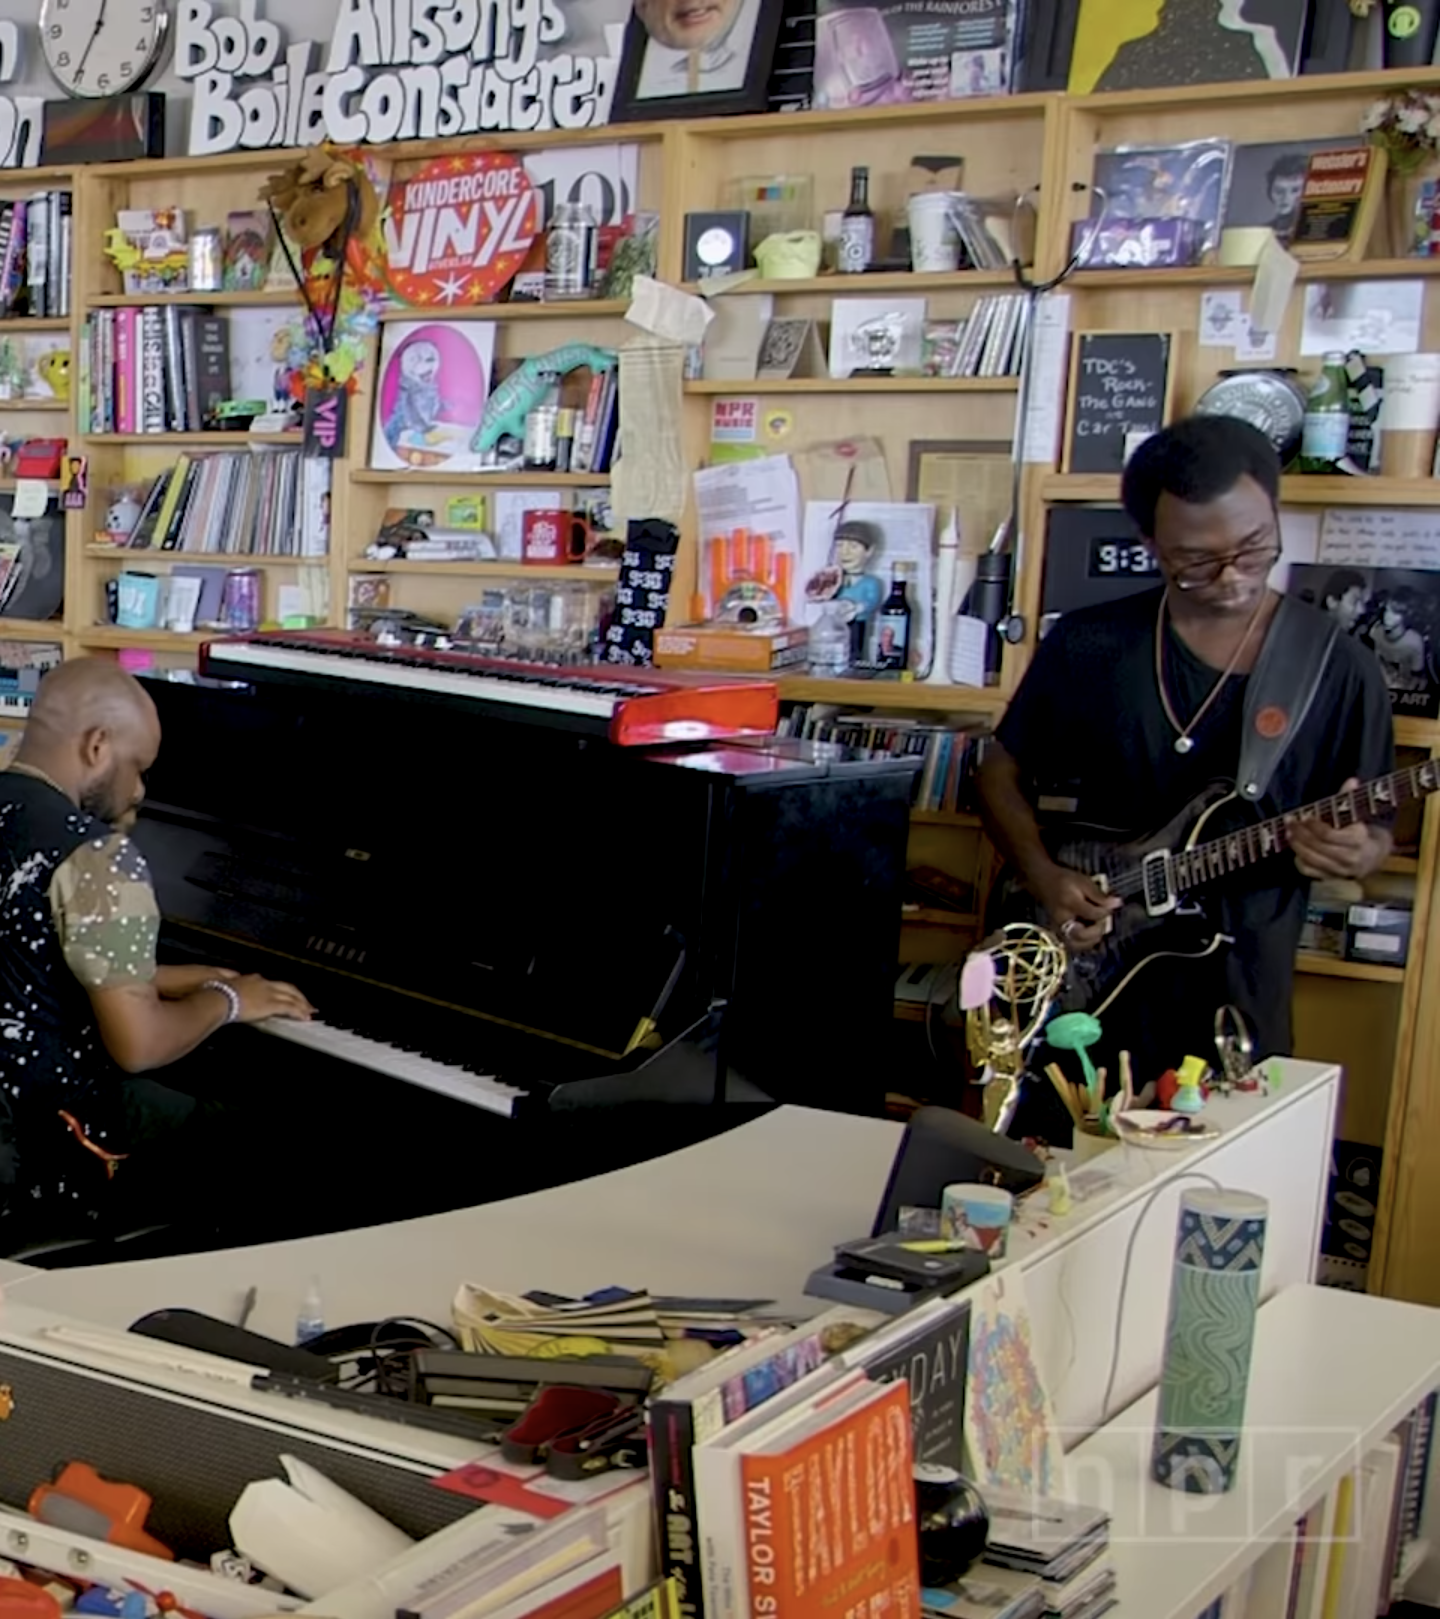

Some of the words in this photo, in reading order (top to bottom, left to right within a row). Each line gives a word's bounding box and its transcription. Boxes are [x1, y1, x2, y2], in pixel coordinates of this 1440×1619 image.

[140, 6, 153, 23] 3
[50, 24, 62, 39] 9
[175, 0, 279, 77] Bob
[135, 36, 147, 51] 4
[57, 51, 70, 67] 8
[120, 61, 133, 77] 5
[97, 73, 110, 89] 6
[189, 41, 328, 156] Boile
[404, 166, 520, 211] KINDERCORE
[384, 190, 533, 274] VINYL
[715, 402, 754, 417] NPR
[314, 396, 338, 448] VIP
[715, 417, 754, 428] MUSIC
[1099, 545, 1158, 573] 9:3
[628, 570, 662, 590] 9:30
[621, 608, 656, 628] 9:30
[782, 1404, 912, 1597] TAYLOR
[666, 1513, 693, 1565] ART
[748, 1477, 776, 1586] TAYLOR
